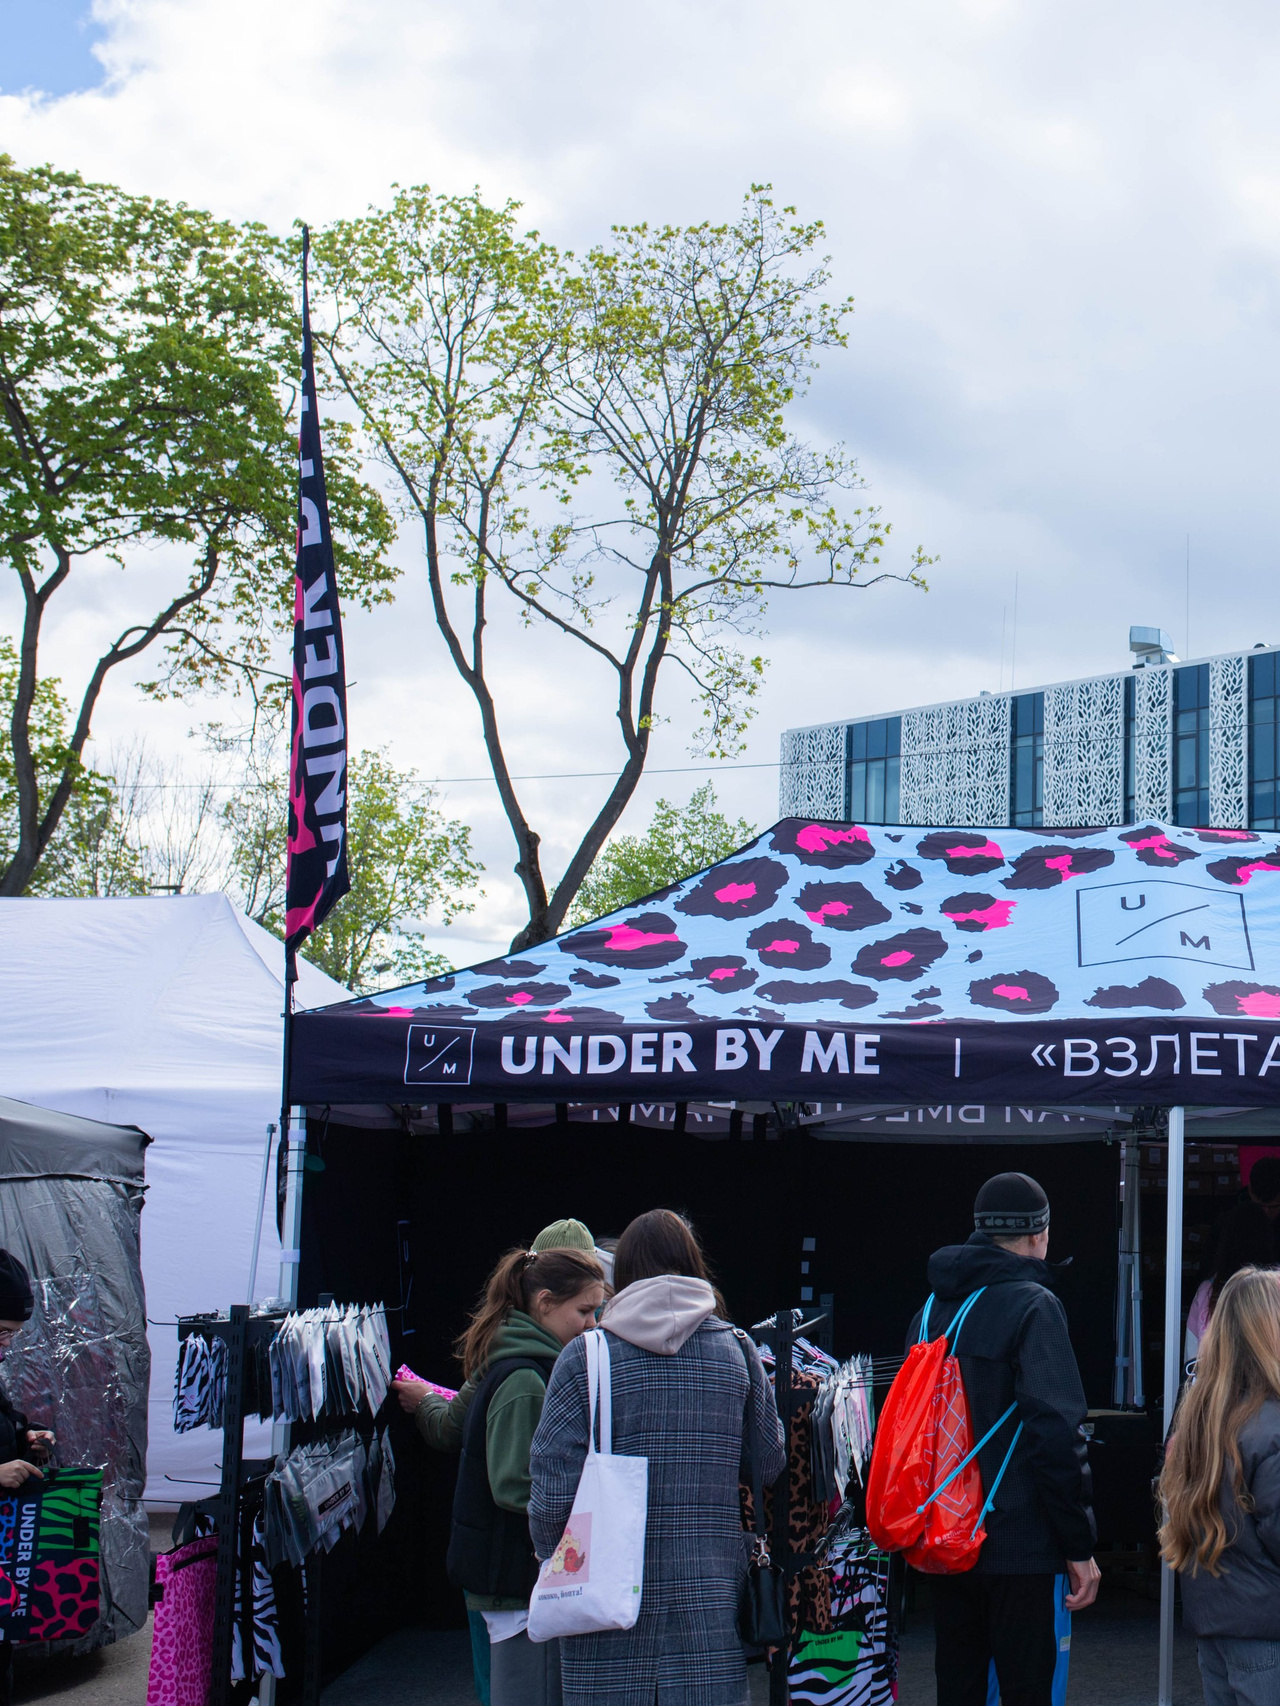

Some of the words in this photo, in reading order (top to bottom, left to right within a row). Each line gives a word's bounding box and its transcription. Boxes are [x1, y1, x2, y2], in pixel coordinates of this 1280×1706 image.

[501, 1032, 698, 1075] UNDER
[714, 1028, 785, 1071] BY
[800, 1031, 881, 1075] ME
[18, 1503, 37, 1563] UNDER
[15, 1567, 31, 1589] BY
[815, 1638, 830, 1646] UNDER
